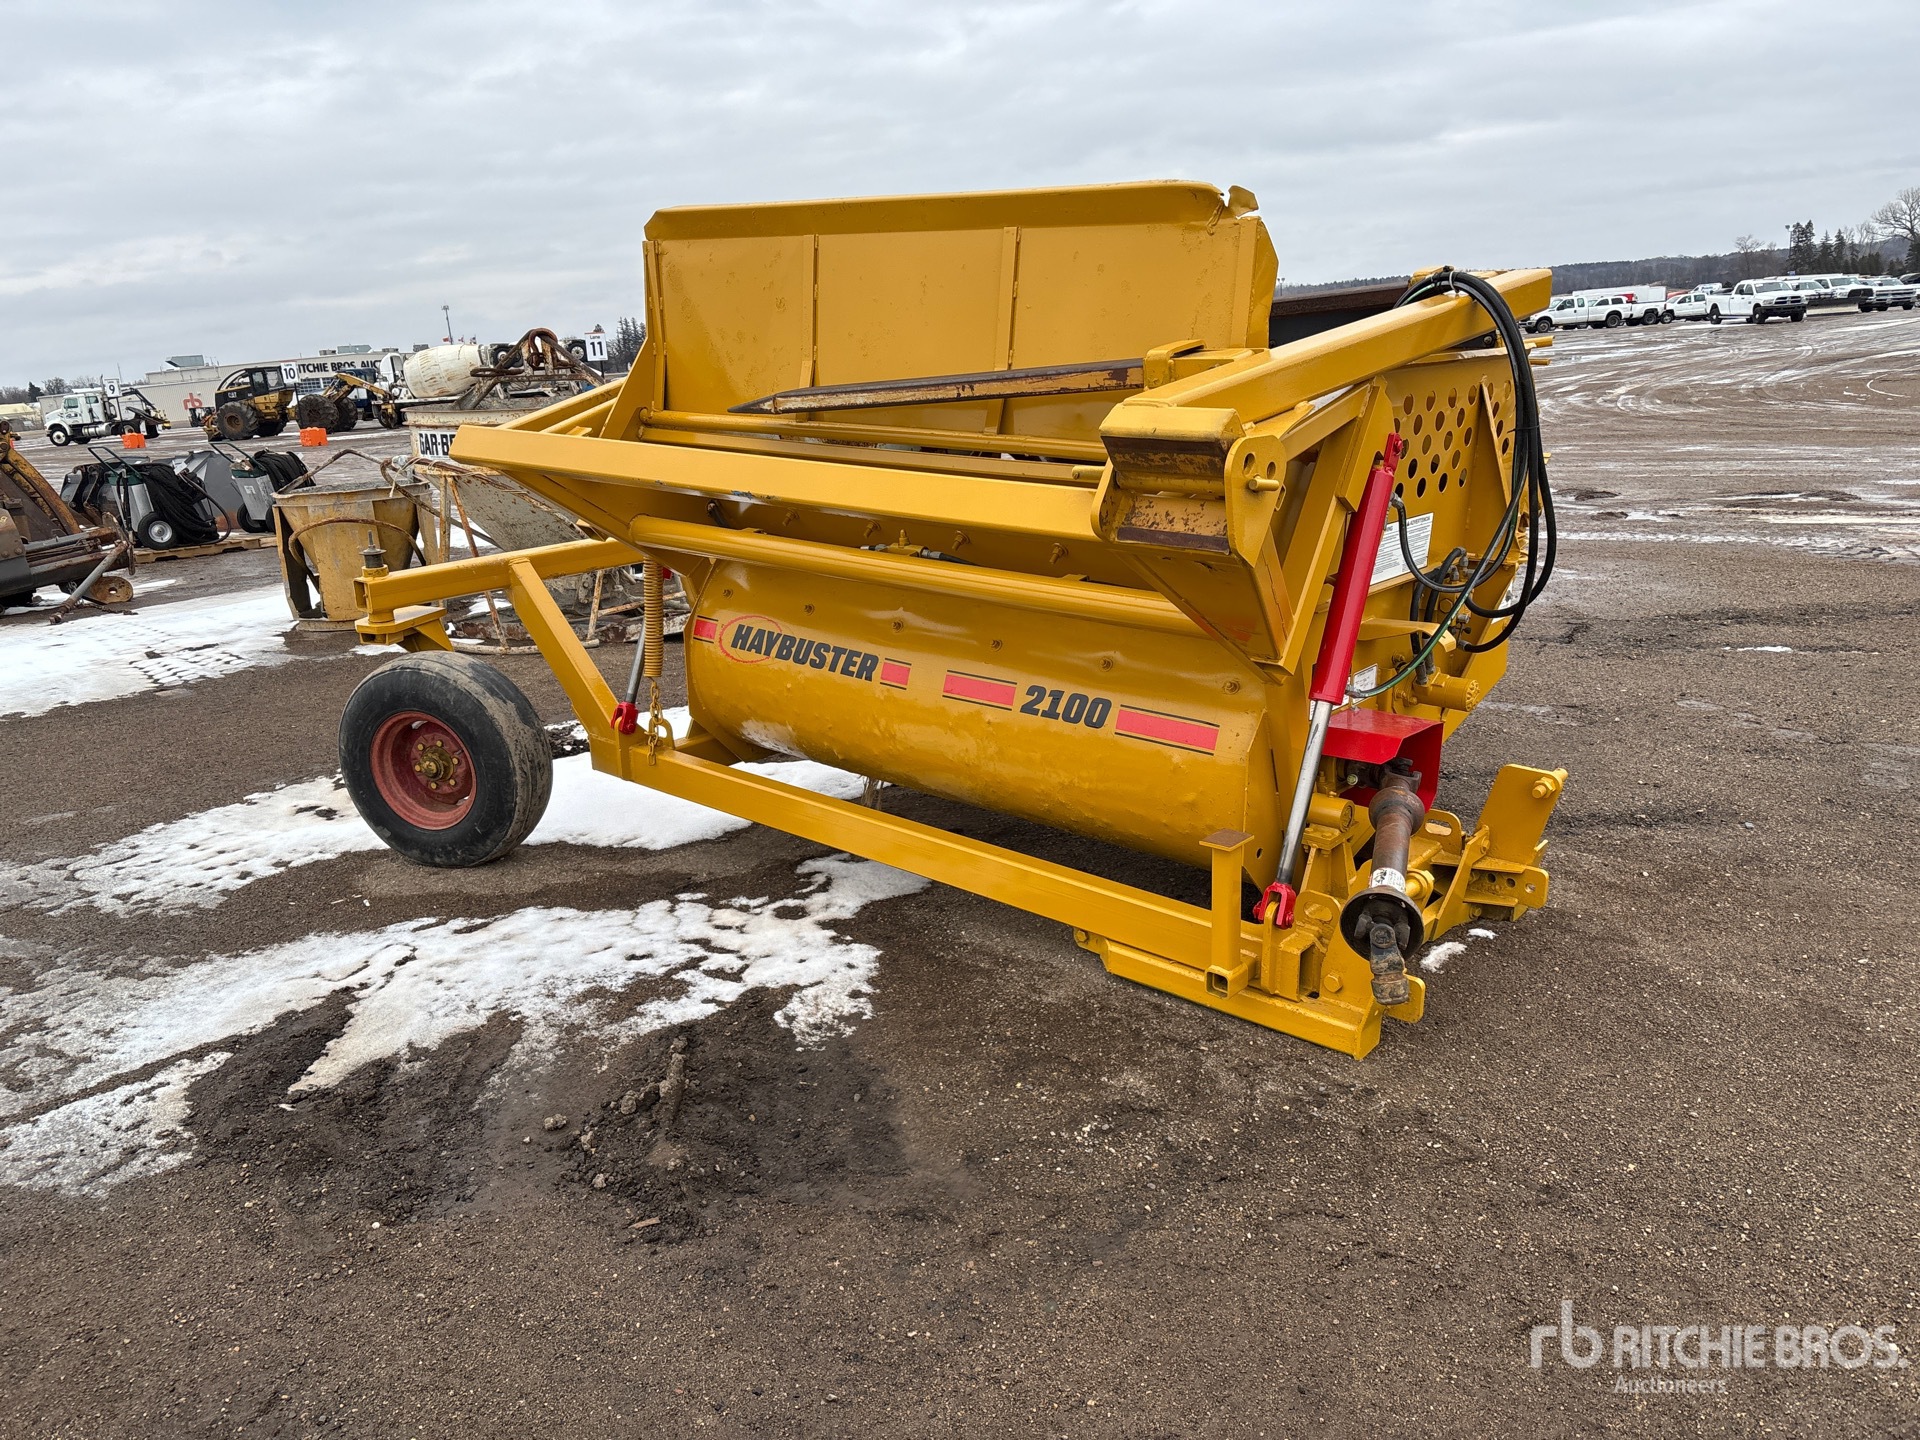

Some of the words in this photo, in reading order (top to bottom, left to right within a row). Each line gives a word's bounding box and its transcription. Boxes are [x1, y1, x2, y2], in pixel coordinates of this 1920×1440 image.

[590, 341, 604, 357] 11
[283, 367, 296, 380] 10
[298, 362, 329, 374] ITCHIE
[108, 384, 116, 395] 9
[730, 624, 880, 682] HAYBUSTER
[1020, 685, 1112, 729] 2100
